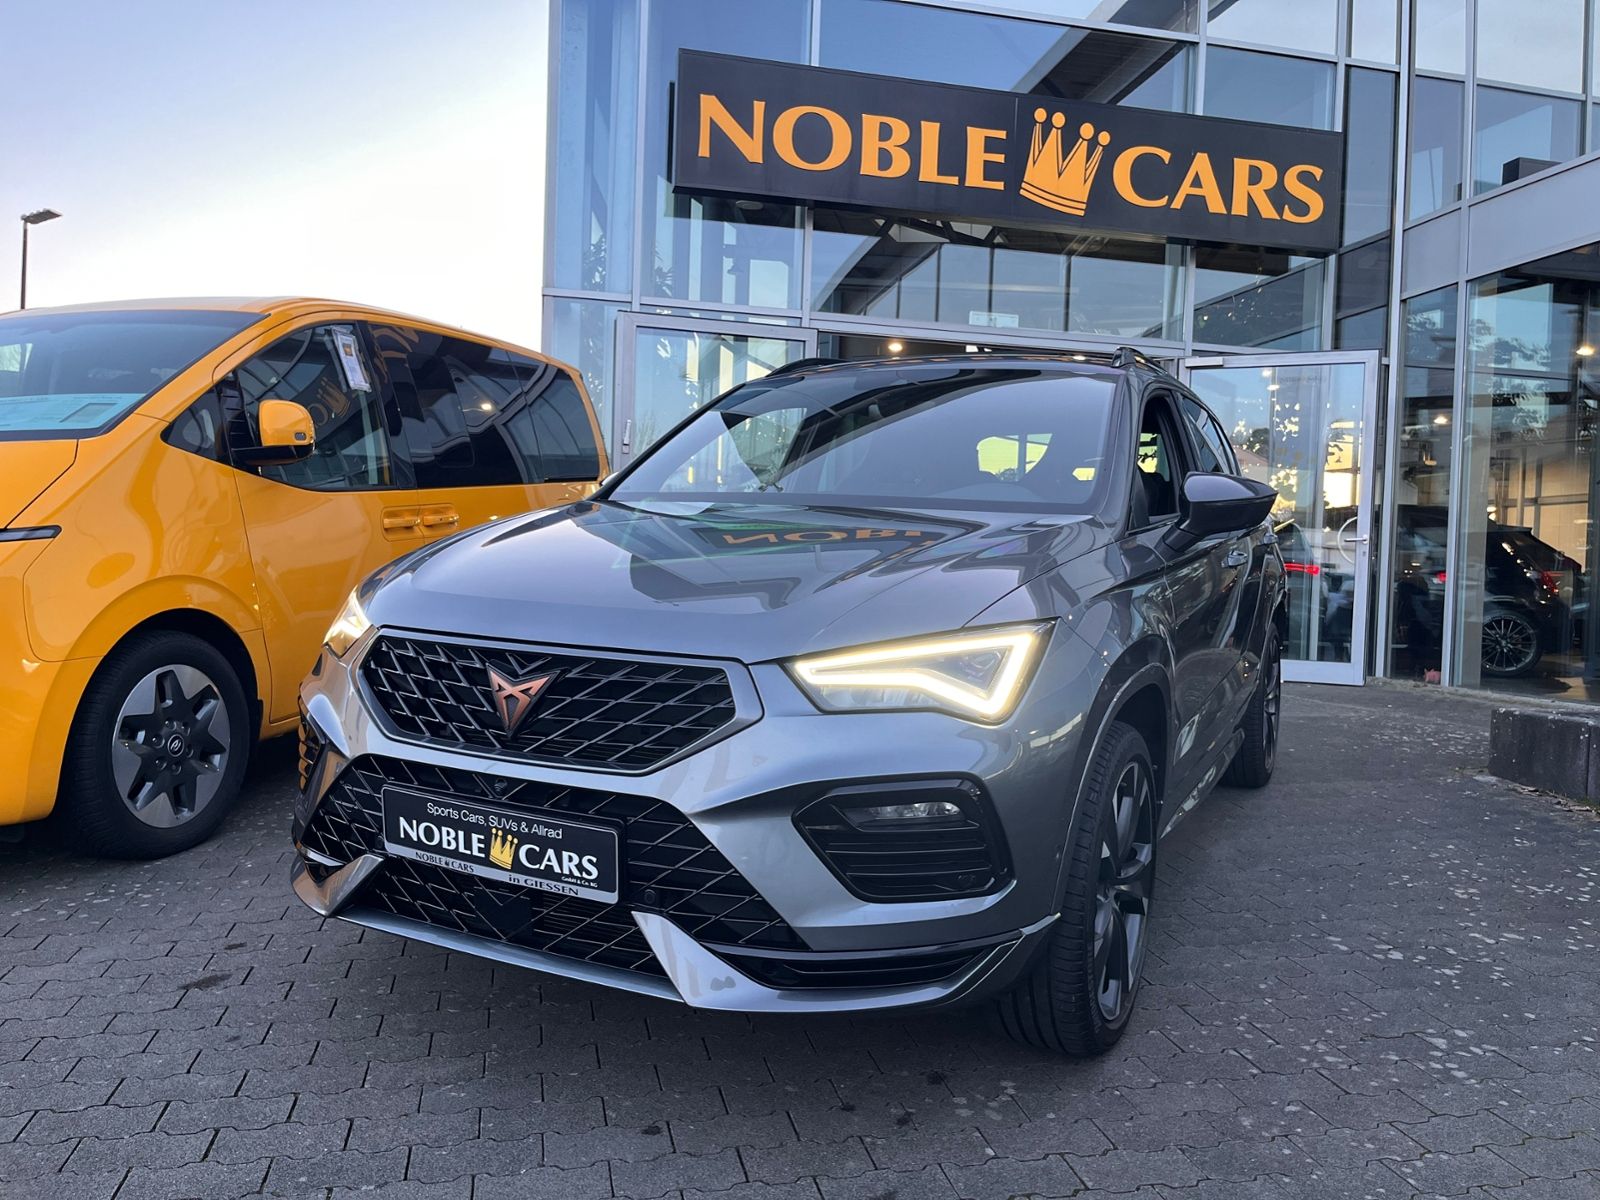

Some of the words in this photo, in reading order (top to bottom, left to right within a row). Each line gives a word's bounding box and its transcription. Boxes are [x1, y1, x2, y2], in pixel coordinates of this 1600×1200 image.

[697, 93, 1008, 190] NOBLE
[1112, 145, 1325, 223] CARS
[427, 802, 459, 819] Sports
[460, 810, 487, 826] Cars,
[488, 815, 518, 831] SUVs
[520, 821, 529, 833] &
[531, 824, 562, 839] Allrad
[399, 816, 486, 858] NOBLE
[519, 844, 599, 880] CARS
[415, 851, 443, 866] NOBLE
[451, 861, 474, 873] CARS
[508, 874, 521, 884] in
[524, 878, 579, 896] GIESSEN
